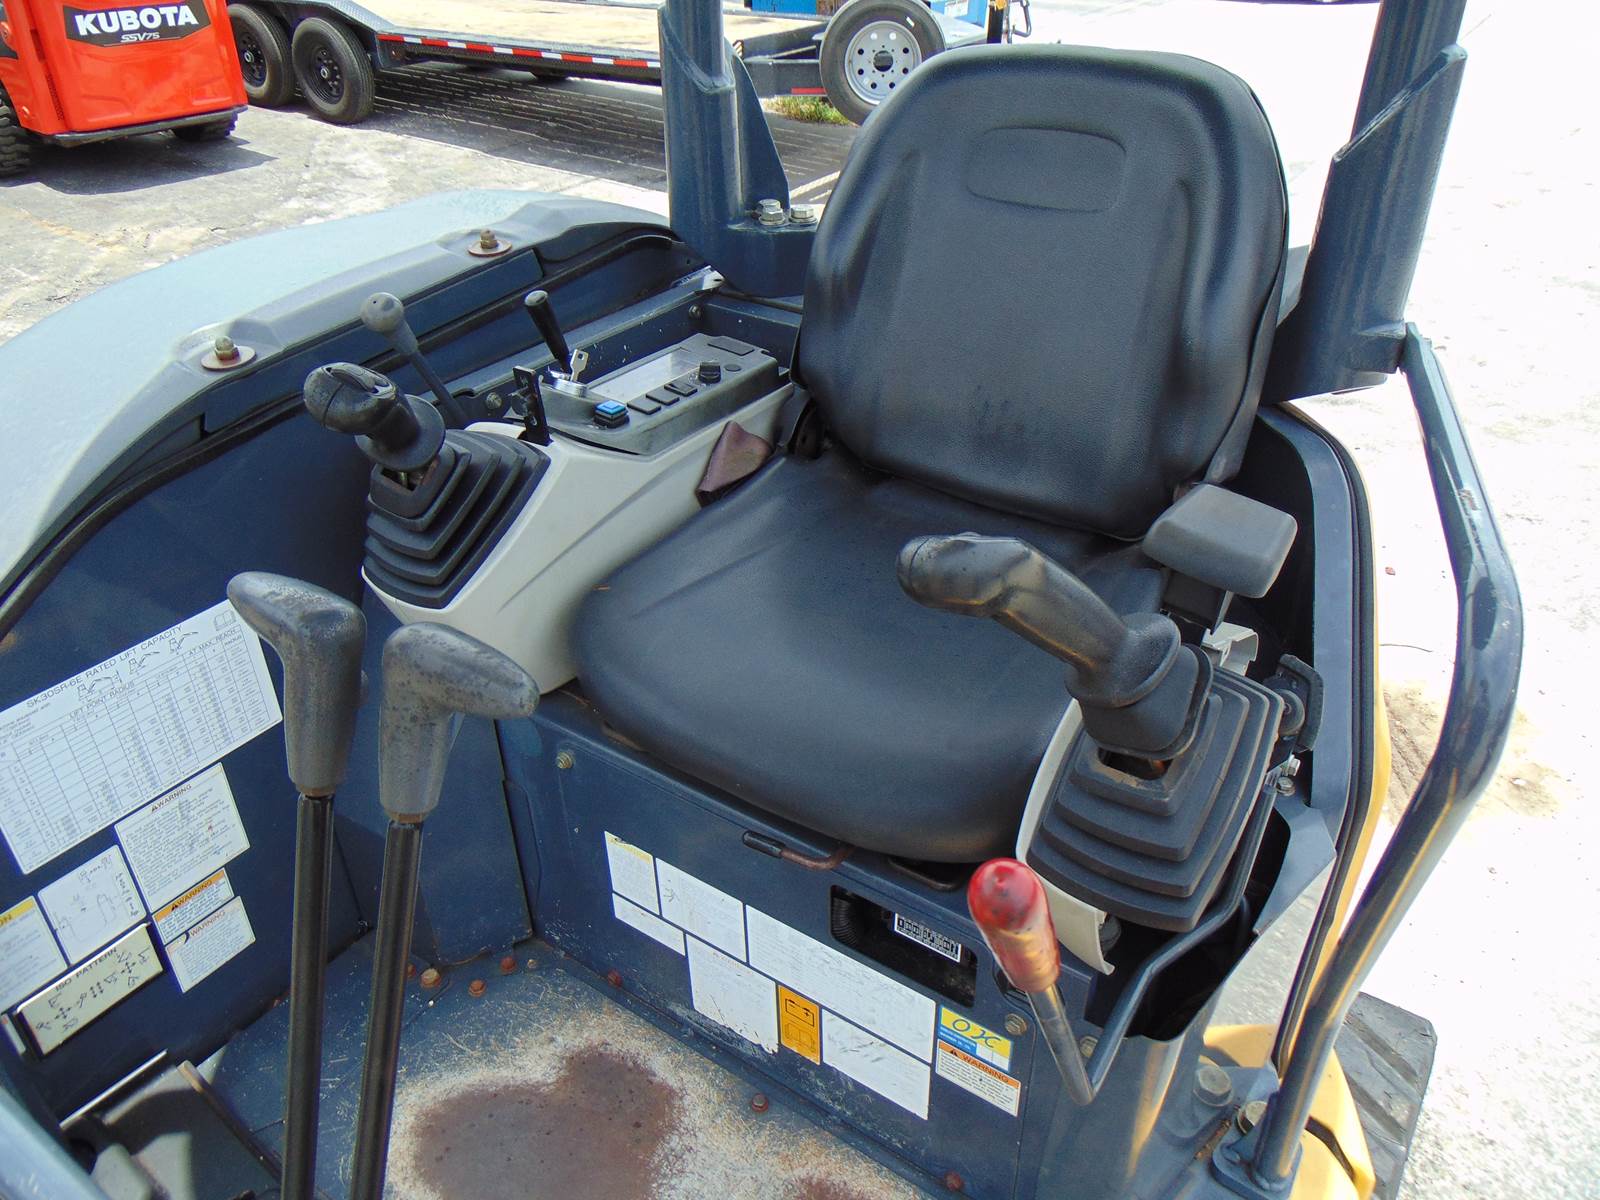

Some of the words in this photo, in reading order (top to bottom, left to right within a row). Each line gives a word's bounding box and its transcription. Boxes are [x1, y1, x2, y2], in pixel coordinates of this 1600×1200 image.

[75, 5, 199, 36] KUBOTA
[120, 32, 160, 43] SSV75
[85, 659, 116, 678] RATED
[119, 648, 137, 661] LIFT
[140, 625, 183, 650] CAPACITY
[157, 784, 192, 807] WARNING
[177, 879, 212, 905] WARNING
[191, 910, 225, 936] WARNING
[54, 977, 72, 991] ISO
[75, 947, 117, 978] PATTERN
[964, 1055, 1008, 1083] WARNING
